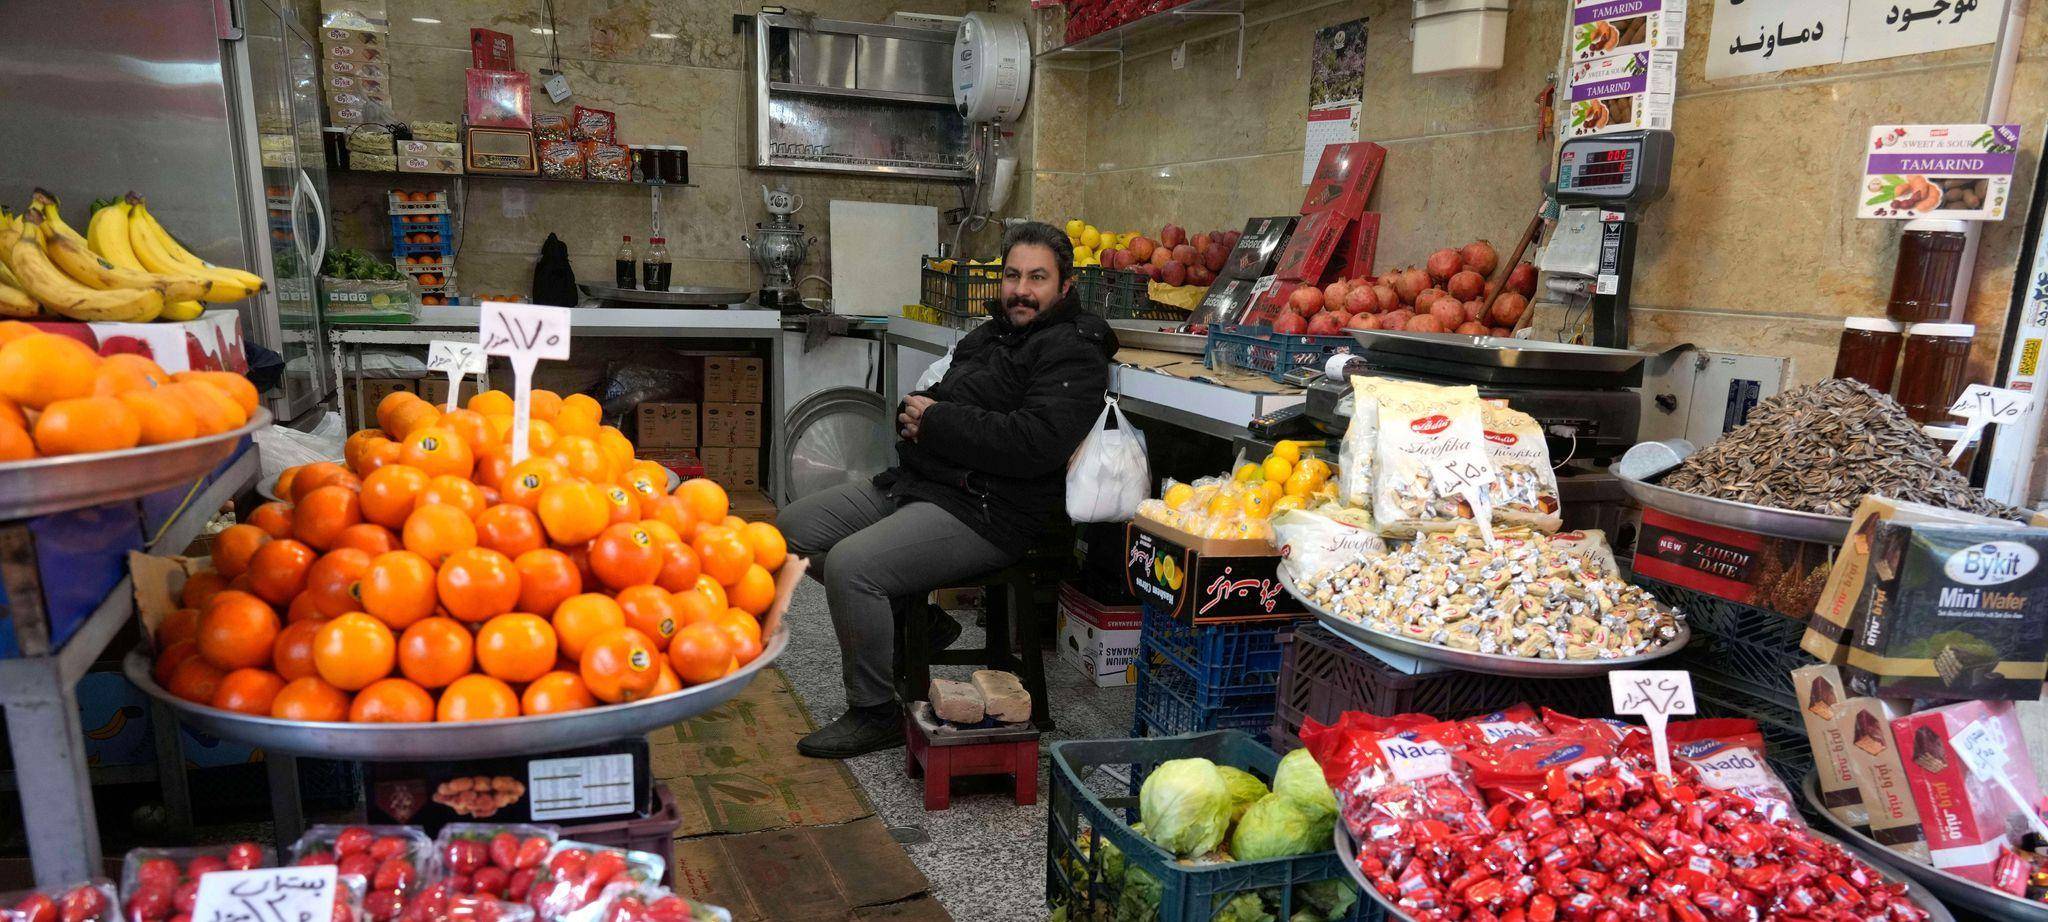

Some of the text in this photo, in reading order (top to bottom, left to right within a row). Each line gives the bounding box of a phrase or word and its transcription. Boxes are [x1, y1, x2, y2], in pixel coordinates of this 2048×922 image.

[1591, 1, 1643, 18] TAMARIND
[1885, 0, 1979, 32] موجود
[1729, 20, 1825, 58] دماوند
[1586, 82, 1631, 97] TAMARIND
[1902, 140, 1935, 149] SWEET
[1947, 140, 1973, 149] SOUR
[1997, 125, 2017, 143] NEW
[1900, 158, 1984, 171] TAMARIND
[498, 311, 560, 350] ۱۷۰
[1975, 391, 2019, 417] ۳۷۰
[1444, 460, 1488, 487] ۳۵۰
[1660, 539, 1683, 551] NEW
[1692, 542, 1751, 566] ZAHEDI
[1699, 557, 1739, 578] DATE
[1963, 551, 2021, 580] Bykit
[1199, 566, 1261, 615] مرکبات
[1938, 586, 2028, 611] Mini Wafer
[1106, 647, 1140, 657] ANANAS
[1700, 755, 1756, 773] Nado
[1943, 808, 1963, 841] مینی
